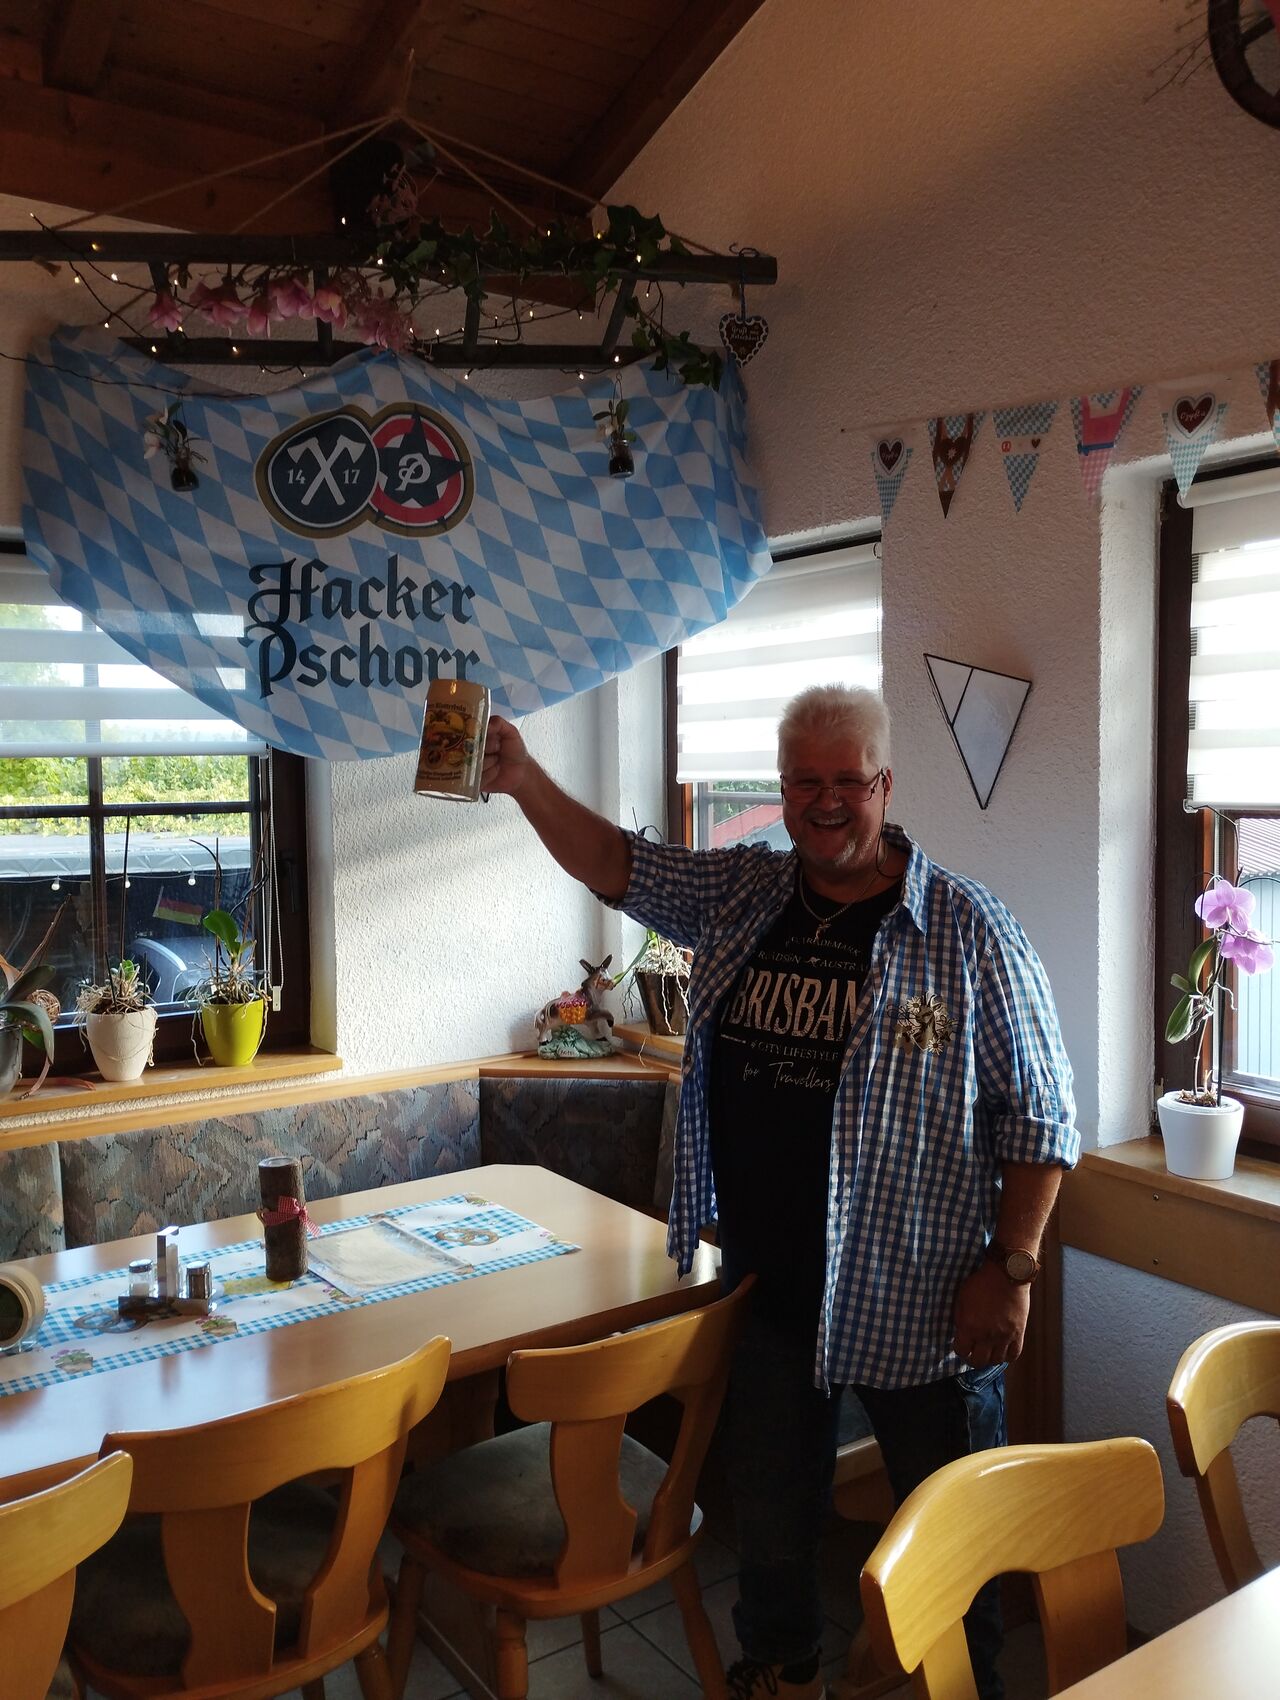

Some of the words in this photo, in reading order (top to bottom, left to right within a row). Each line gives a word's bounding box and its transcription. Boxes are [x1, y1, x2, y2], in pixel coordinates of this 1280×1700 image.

[287, 469, 306, 484] 14
[343, 469, 360, 484] 17
[248, 555, 476, 627] Hacker
[238, 622, 480, 699] Pschorr
[783, 1046, 838, 1061] LIFESTYLE
